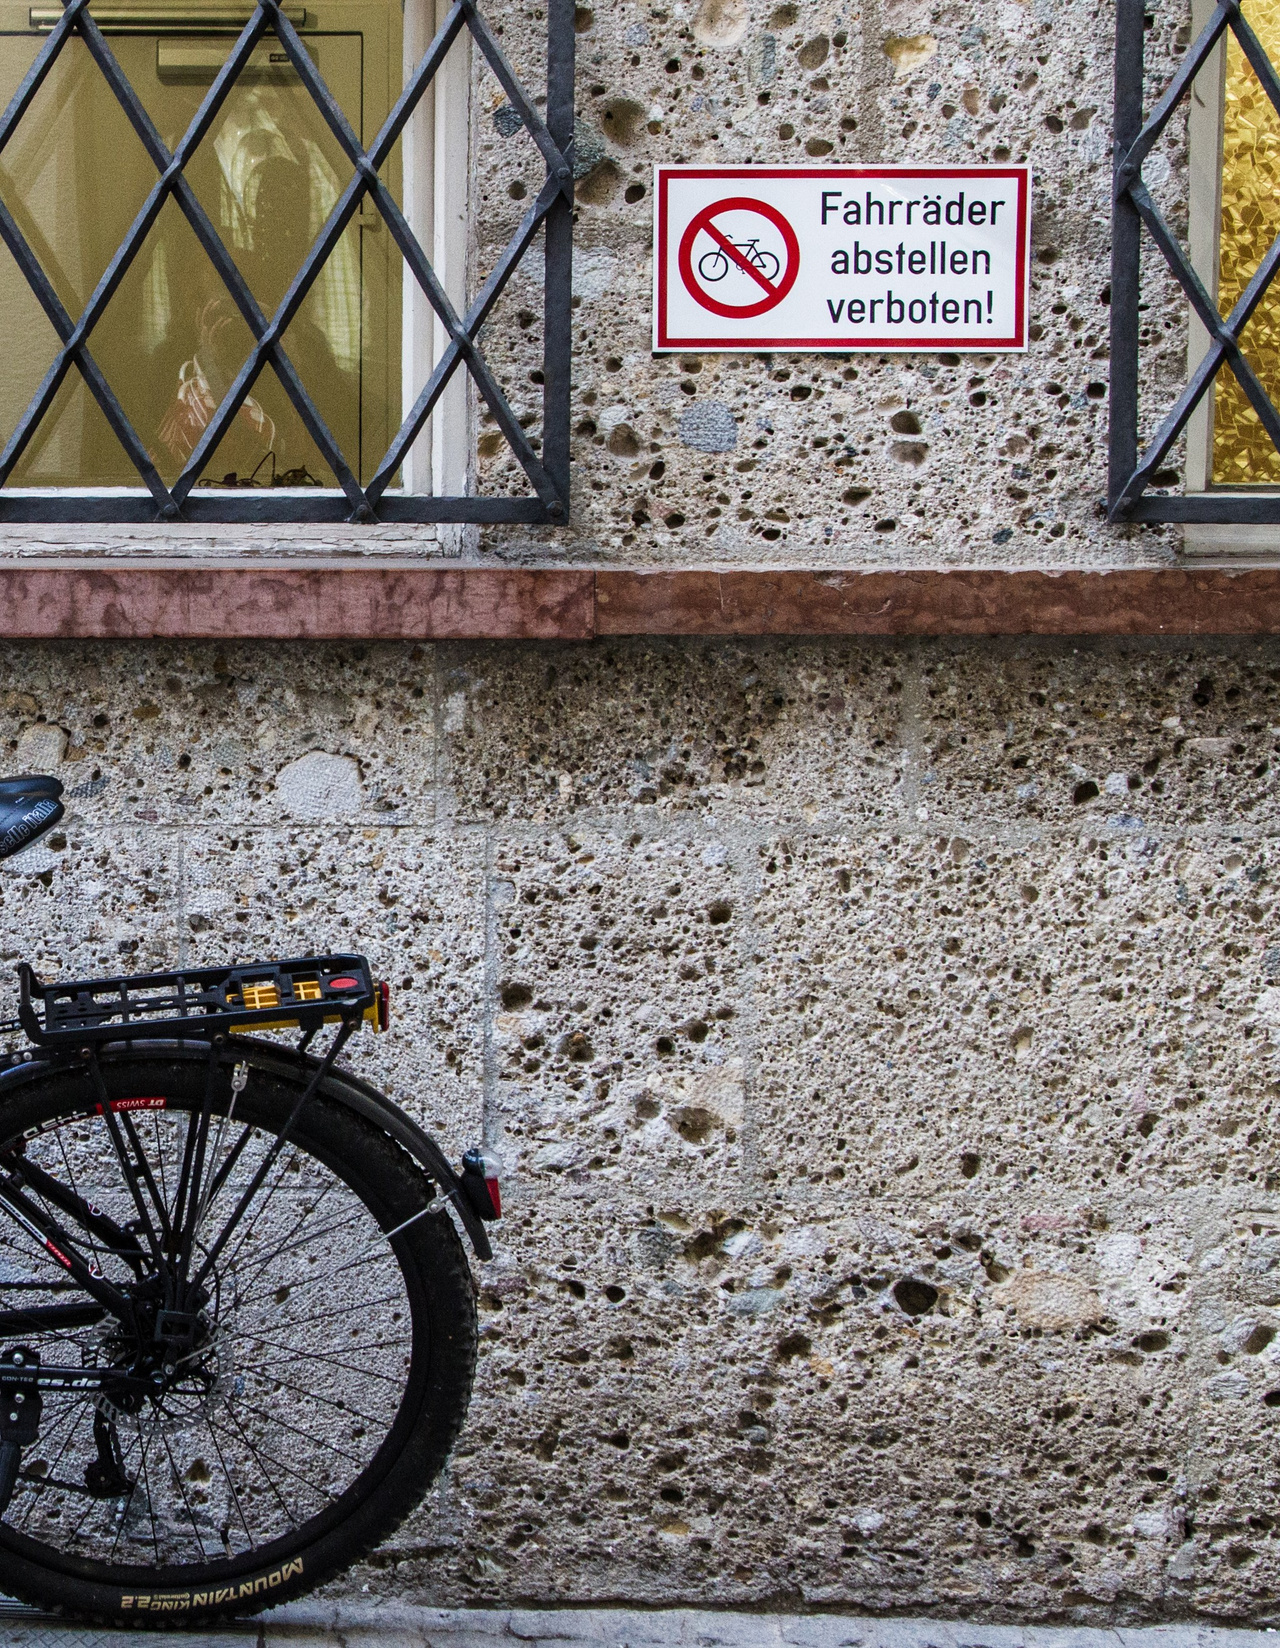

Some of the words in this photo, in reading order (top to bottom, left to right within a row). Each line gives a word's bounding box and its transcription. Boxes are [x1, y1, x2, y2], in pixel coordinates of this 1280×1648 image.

[820, 191, 1005, 226] Fahrräder
[830, 241, 991, 275] abstellen
[827, 290, 994, 325] verboten!
[22, 799, 59, 829] italia
[117, 1099, 146, 1109] SWISS
[147, 1098, 164, 1107] DT
[192, 1556, 305, 1607] MOUNTAIN
[121, 1594, 151, 1609] 2.2
[150, 1600, 190, 1611] KING
